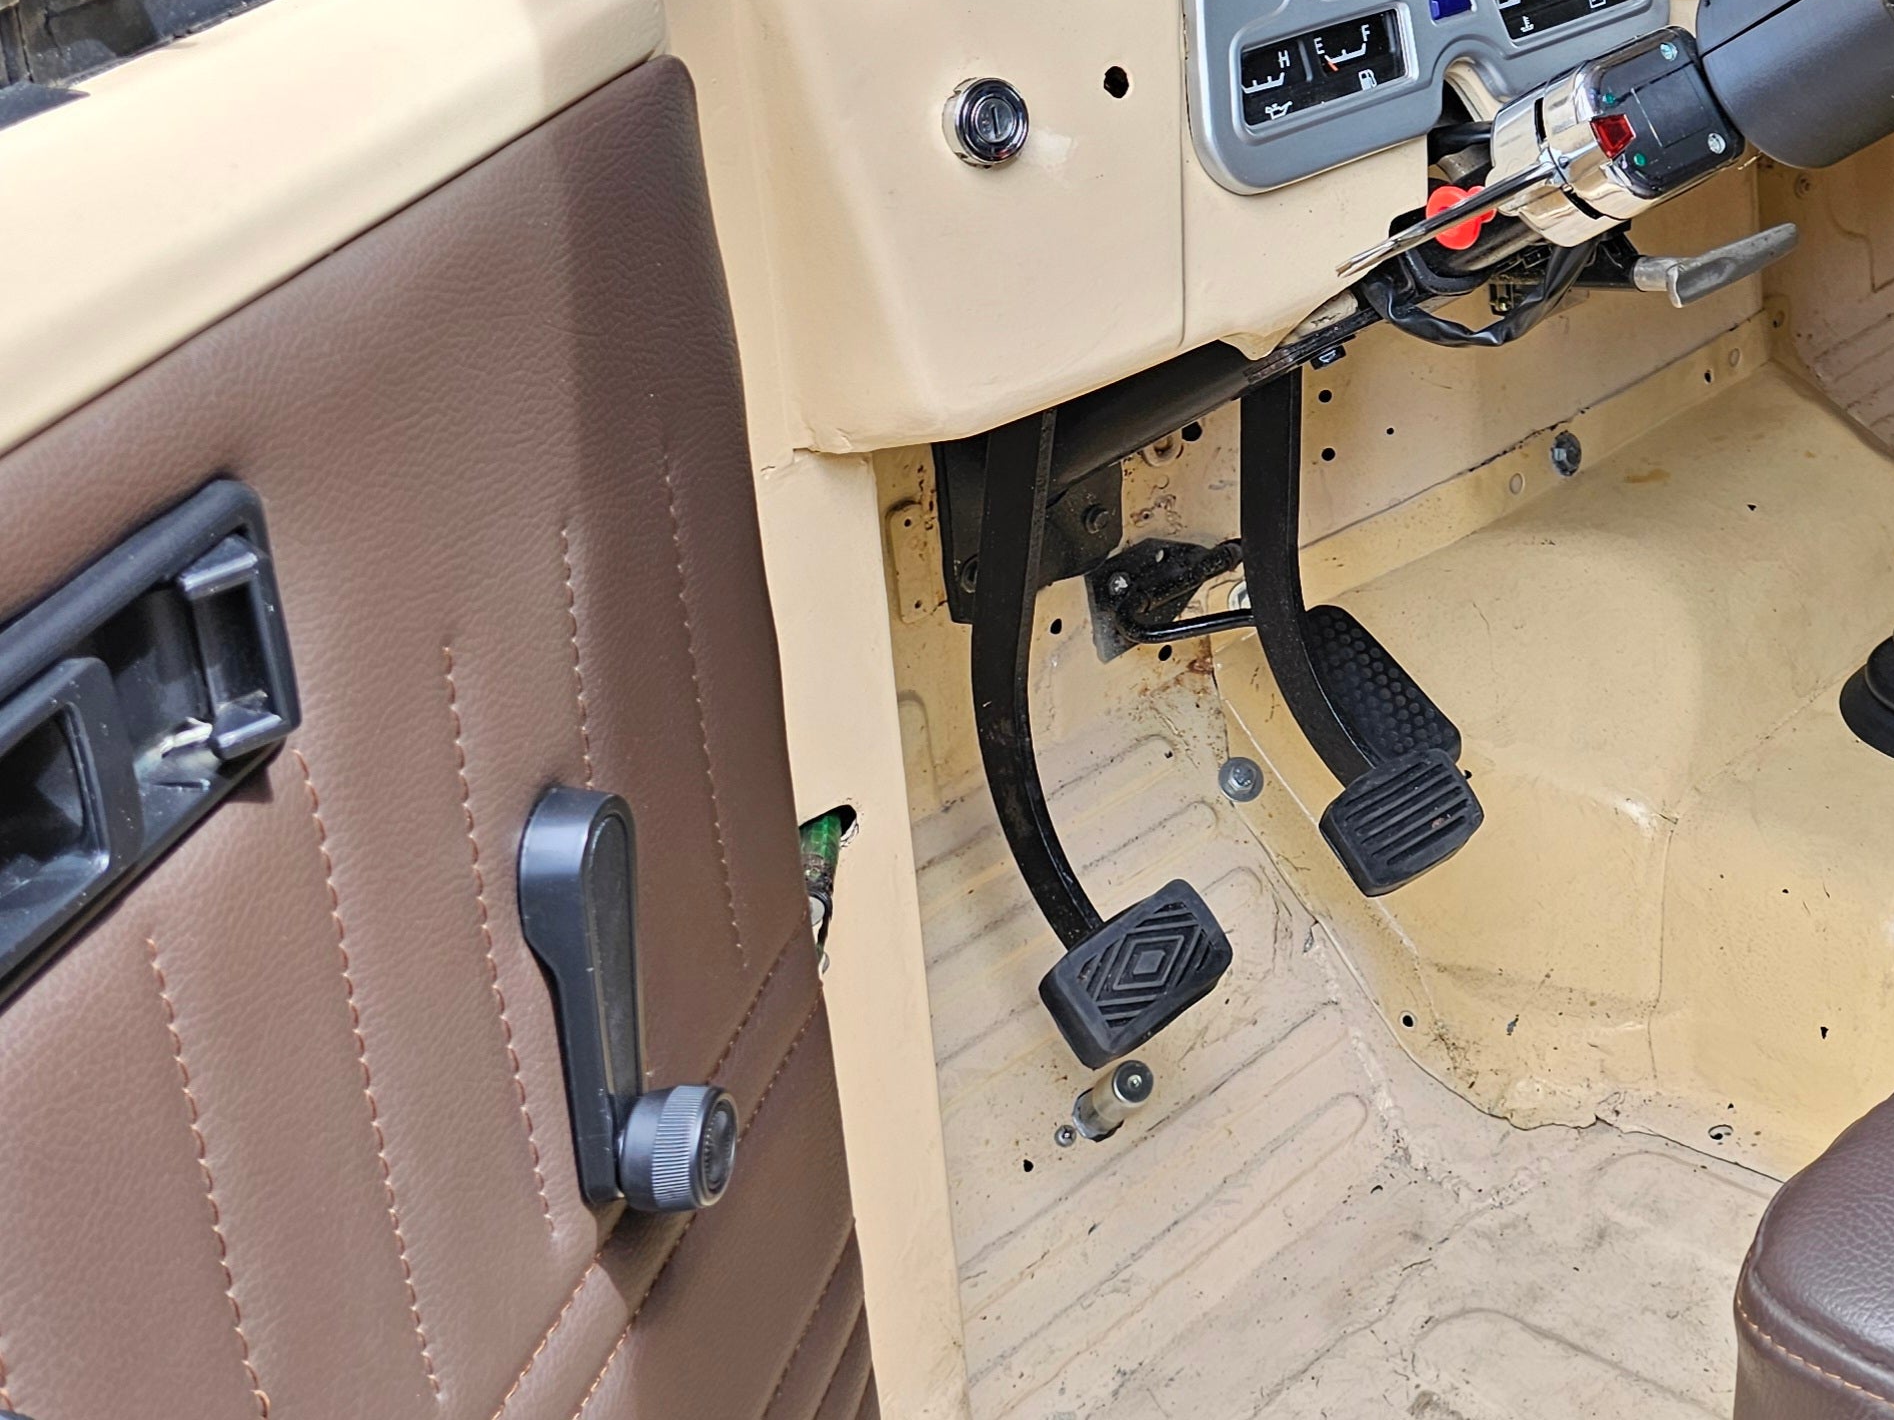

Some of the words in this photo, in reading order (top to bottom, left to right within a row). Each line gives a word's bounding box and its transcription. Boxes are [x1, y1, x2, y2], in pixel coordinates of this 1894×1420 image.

[1314, 37, 1325, 55] E
[1361, 24, 1371, 42] F
[1278, 50, 1290, 68] H
